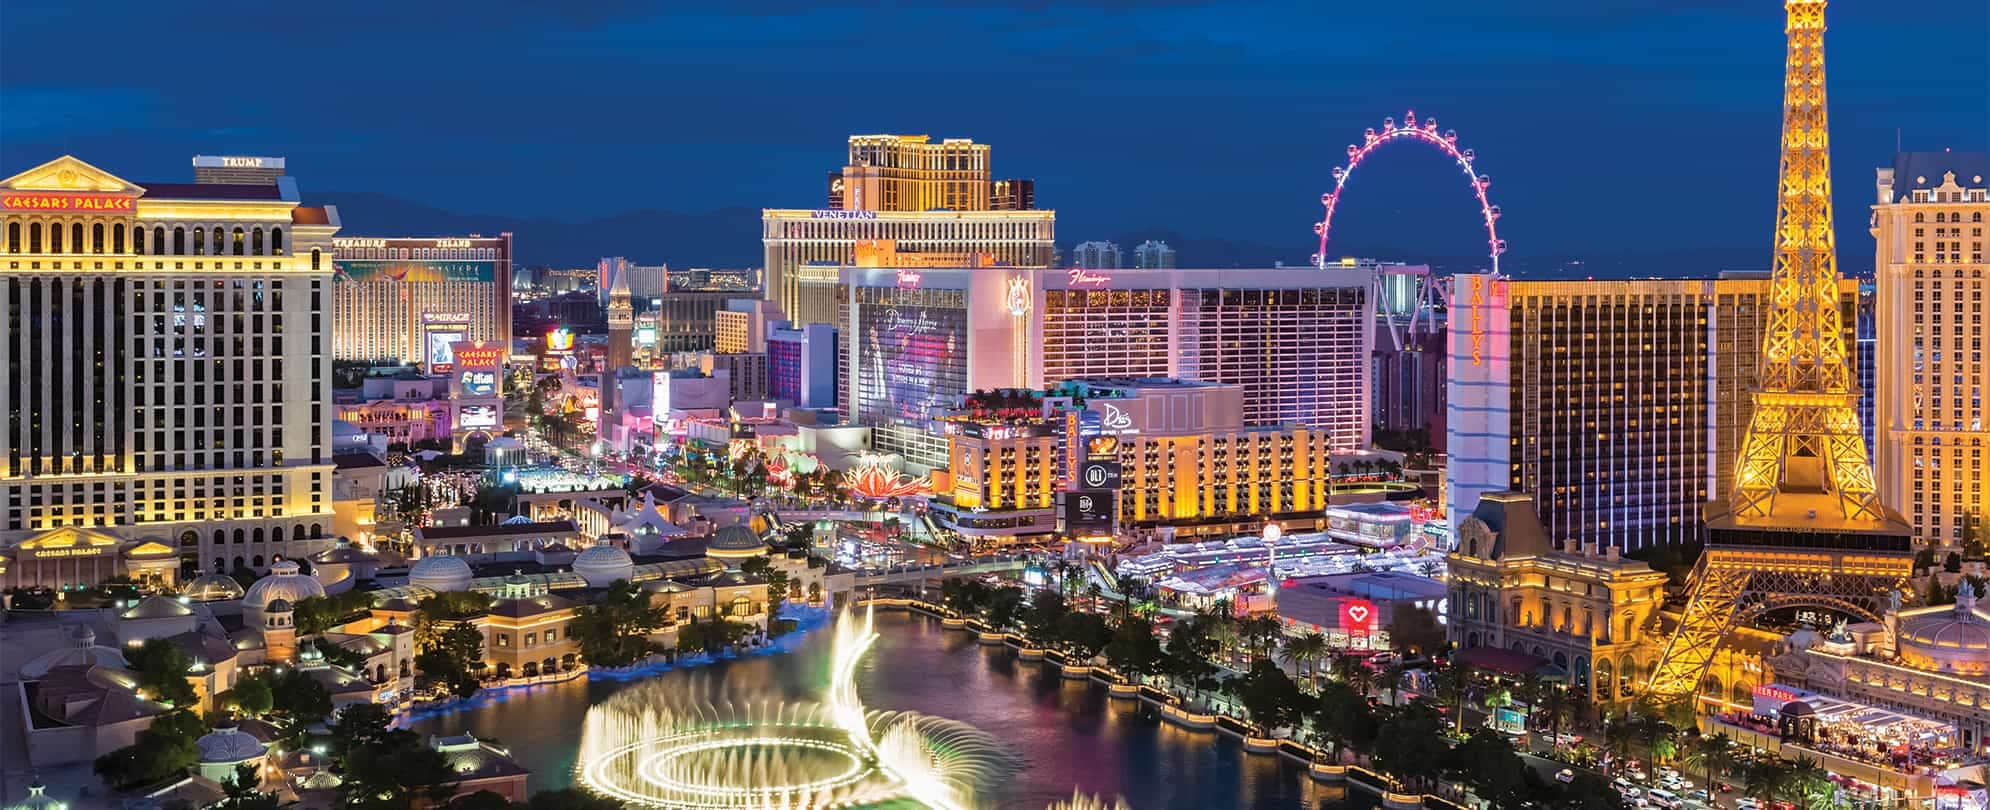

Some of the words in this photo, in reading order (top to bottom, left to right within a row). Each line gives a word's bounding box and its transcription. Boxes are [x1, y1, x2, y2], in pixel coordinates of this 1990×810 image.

[223, 157, 263, 168] TRUMP
[3, 196, 69, 209] CAESARS
[75, 197, 132, 209] PALACE
[815, 210, 874, 219] VENETIAN
[333, 239, 386, 248] TREASURE
[1068, 269, 1111, 286] Flamingo
[459, 351, 497, 359] CAESARS
[461, 359, 496, 367] PALACE
[1773, 690, 1794, 701] PARK
